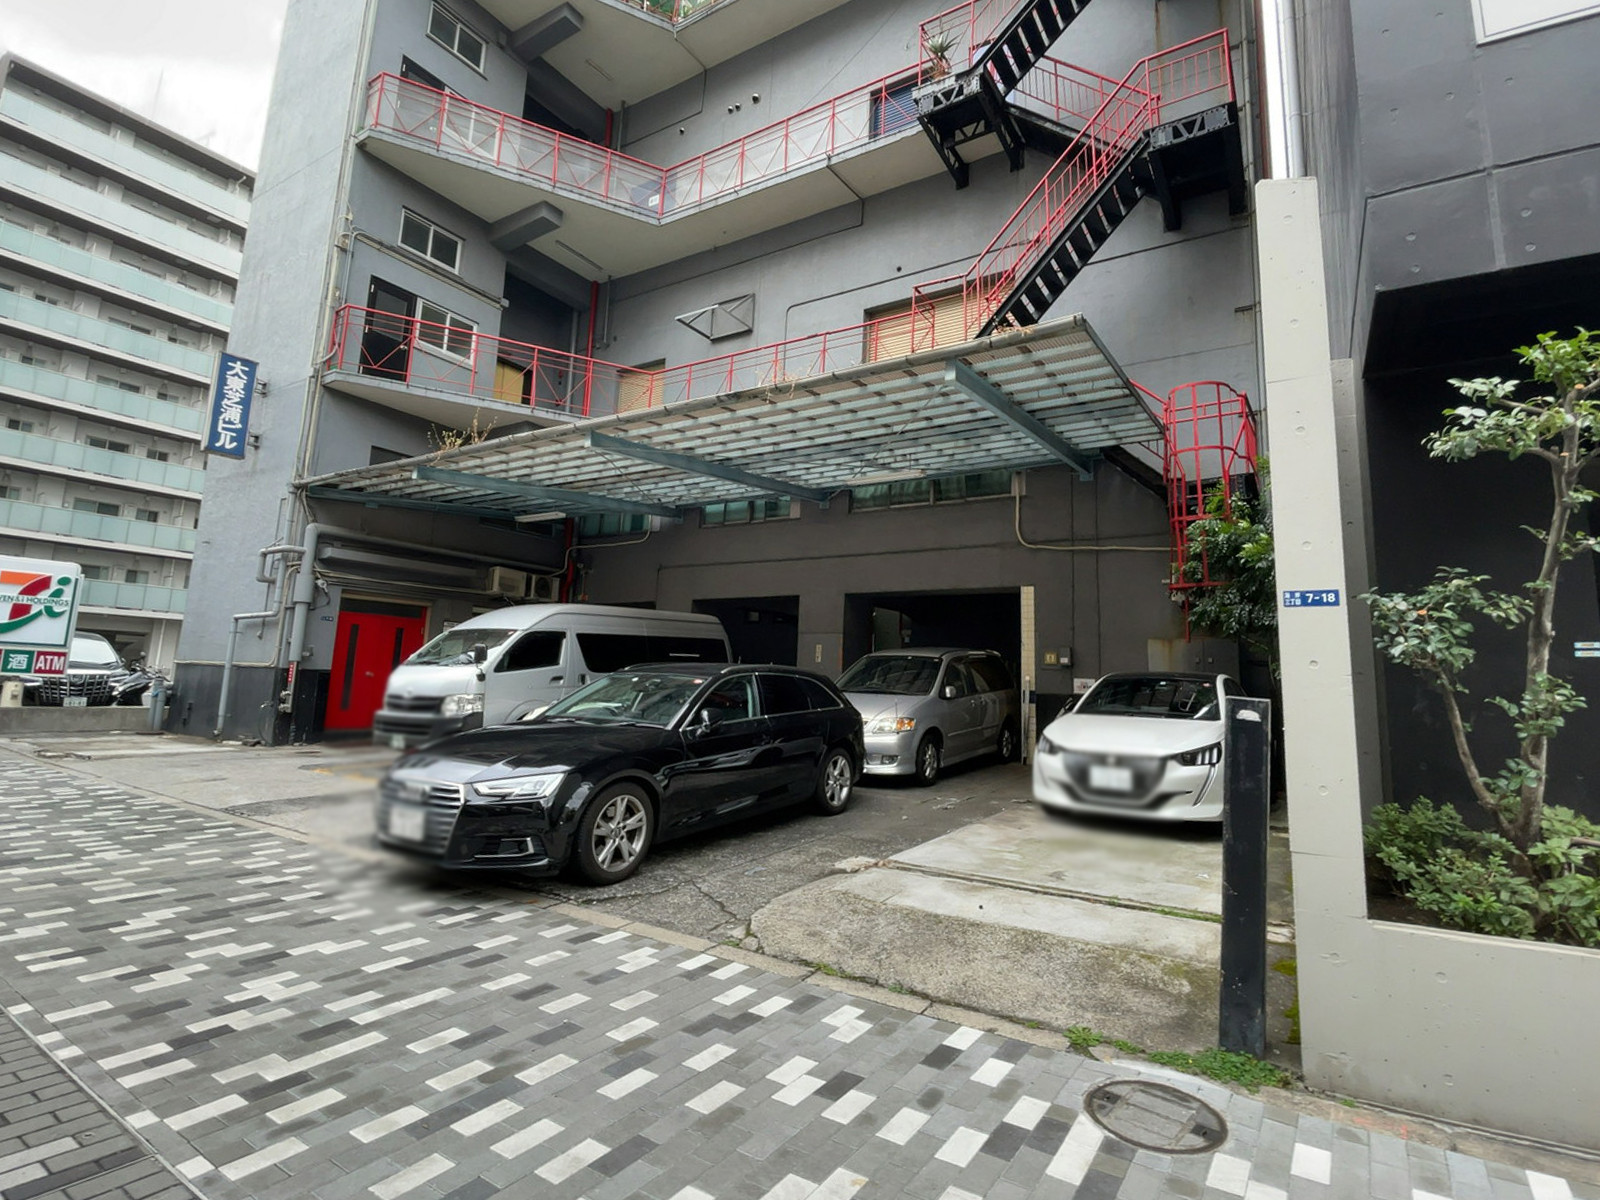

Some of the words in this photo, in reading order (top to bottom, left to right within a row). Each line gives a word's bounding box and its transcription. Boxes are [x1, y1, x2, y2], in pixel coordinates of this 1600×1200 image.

[215, 361, 249, 449] 大東芝浦ビル
[26, 597, 69, 607] HOLDINGS
[1305, 593, 1336, 603] 7-18
[7, 653, 29, 669] 酒
[35, 655, 65, 671] ATM
